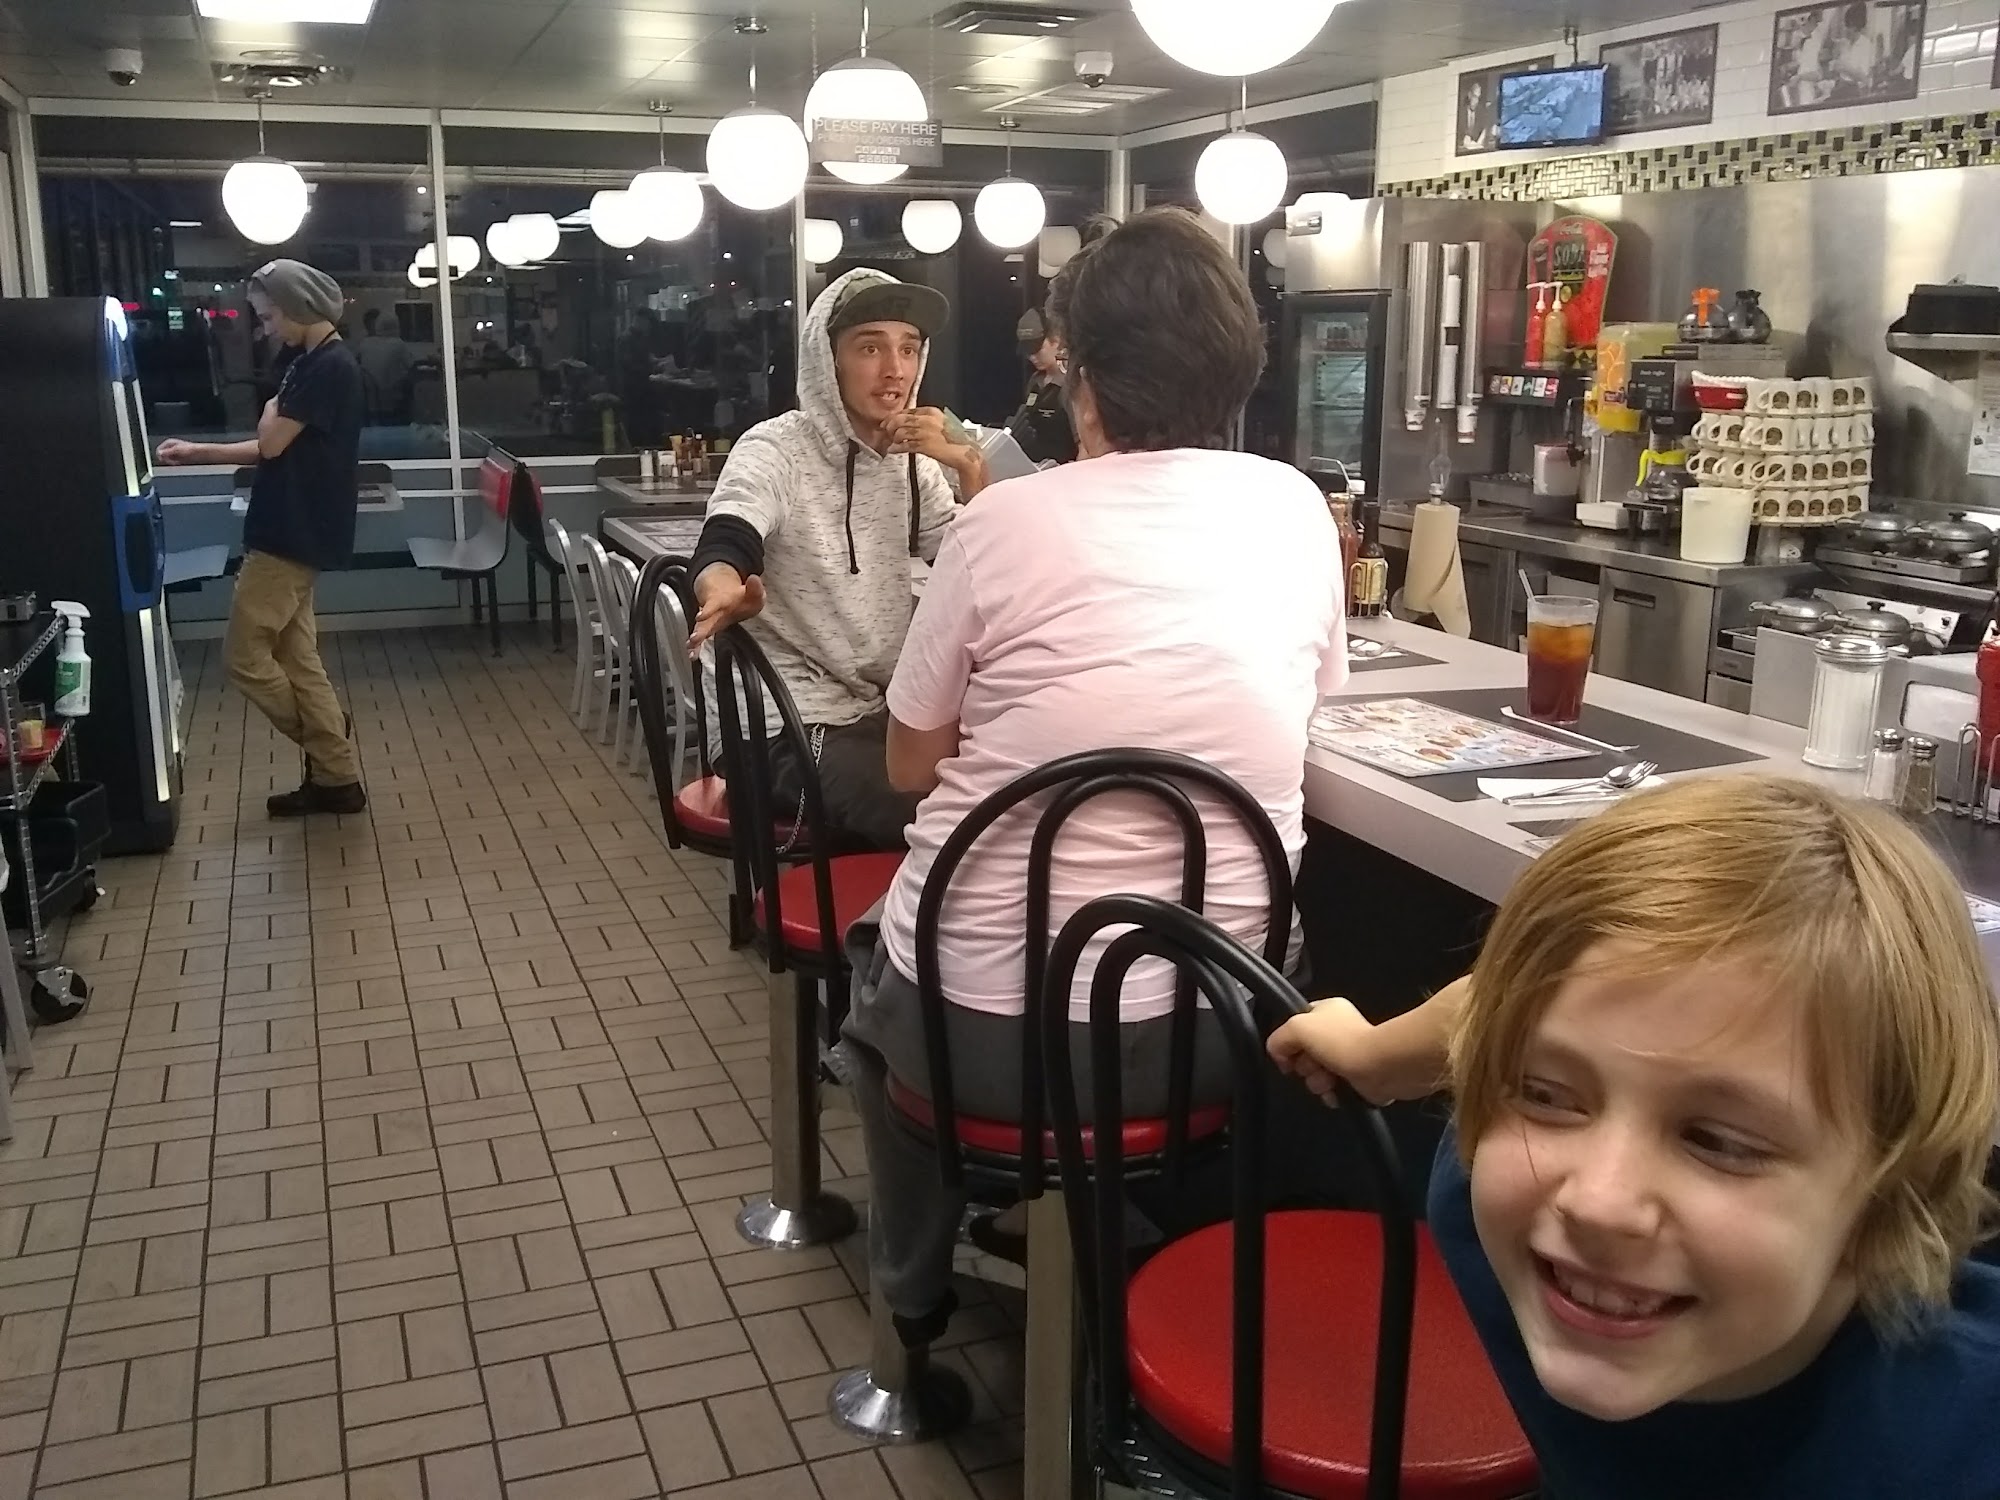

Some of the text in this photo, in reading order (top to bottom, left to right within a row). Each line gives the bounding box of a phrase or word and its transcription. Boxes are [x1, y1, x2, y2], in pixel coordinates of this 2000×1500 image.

[815, 119, 938, 136] PLEASE PAY HERE
[877, 136, 910, 145] ORDERS
[912, 137, 935, 147] HERE
